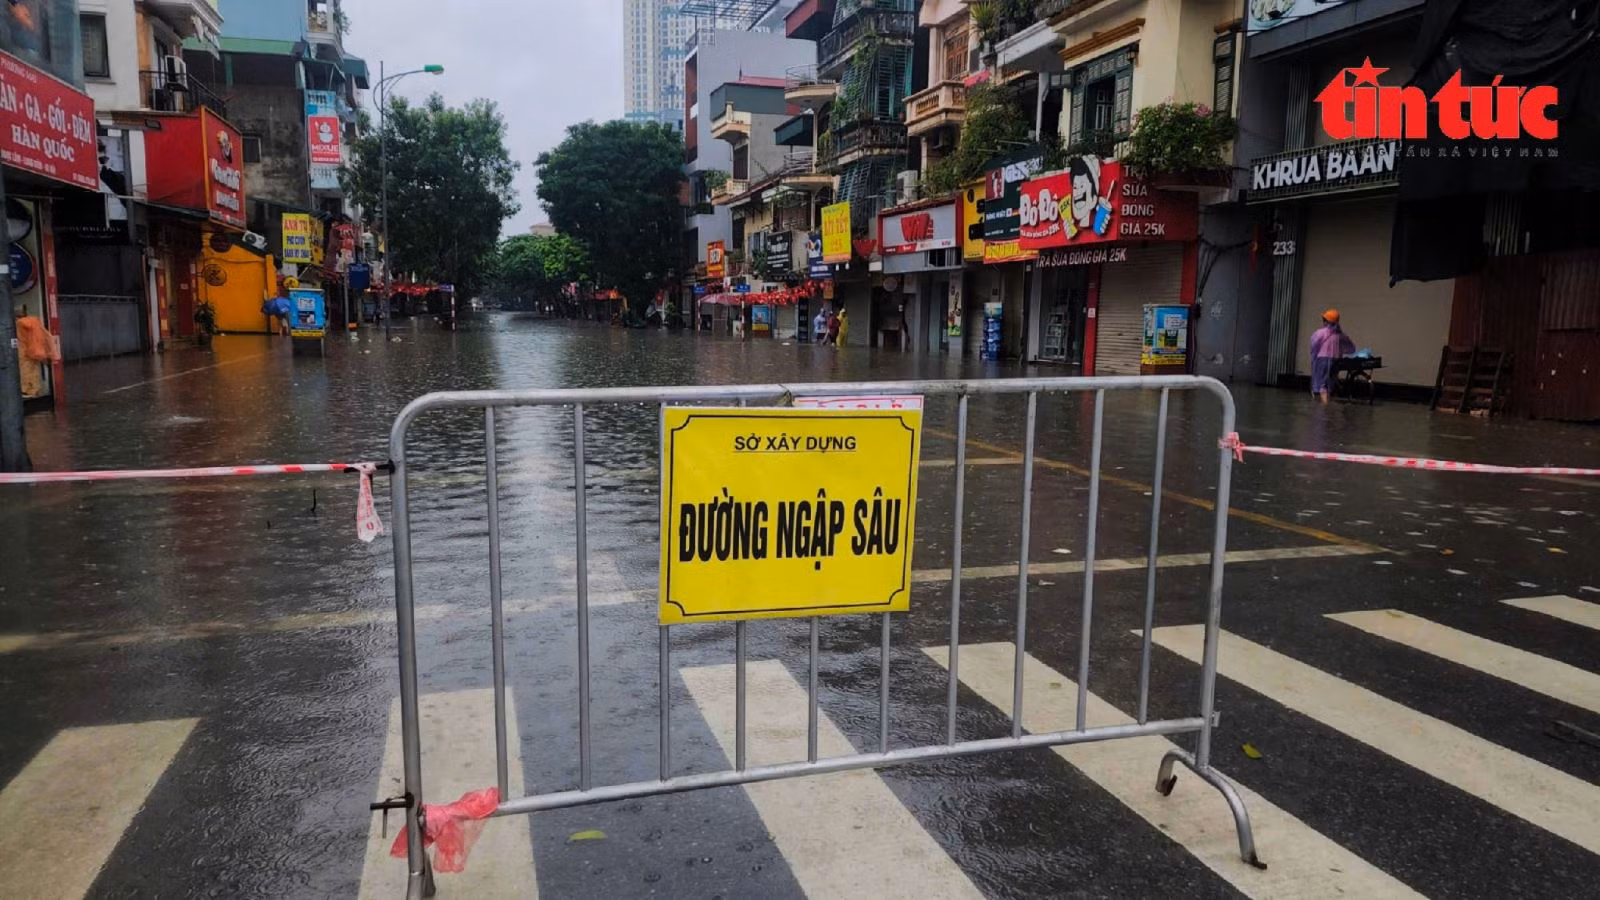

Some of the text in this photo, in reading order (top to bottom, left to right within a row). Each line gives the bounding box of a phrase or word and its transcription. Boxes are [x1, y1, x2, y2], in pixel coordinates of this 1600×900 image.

[11, 123, 41, 151] HÀN
[43, 136, 75, 162] QUỐC
[1253, 155, 1321, 190] KHRUA
[1144, 222, 1165, 236] 25K
[1109, 247, 1127, 262] 25K
[1273, 241, 1293, 256] 233
[734, 432, 857, 453] SỞ XÂY DỰNG
[678, 486, 901, 570] ĐƯỜNG NGẬP SÂU
